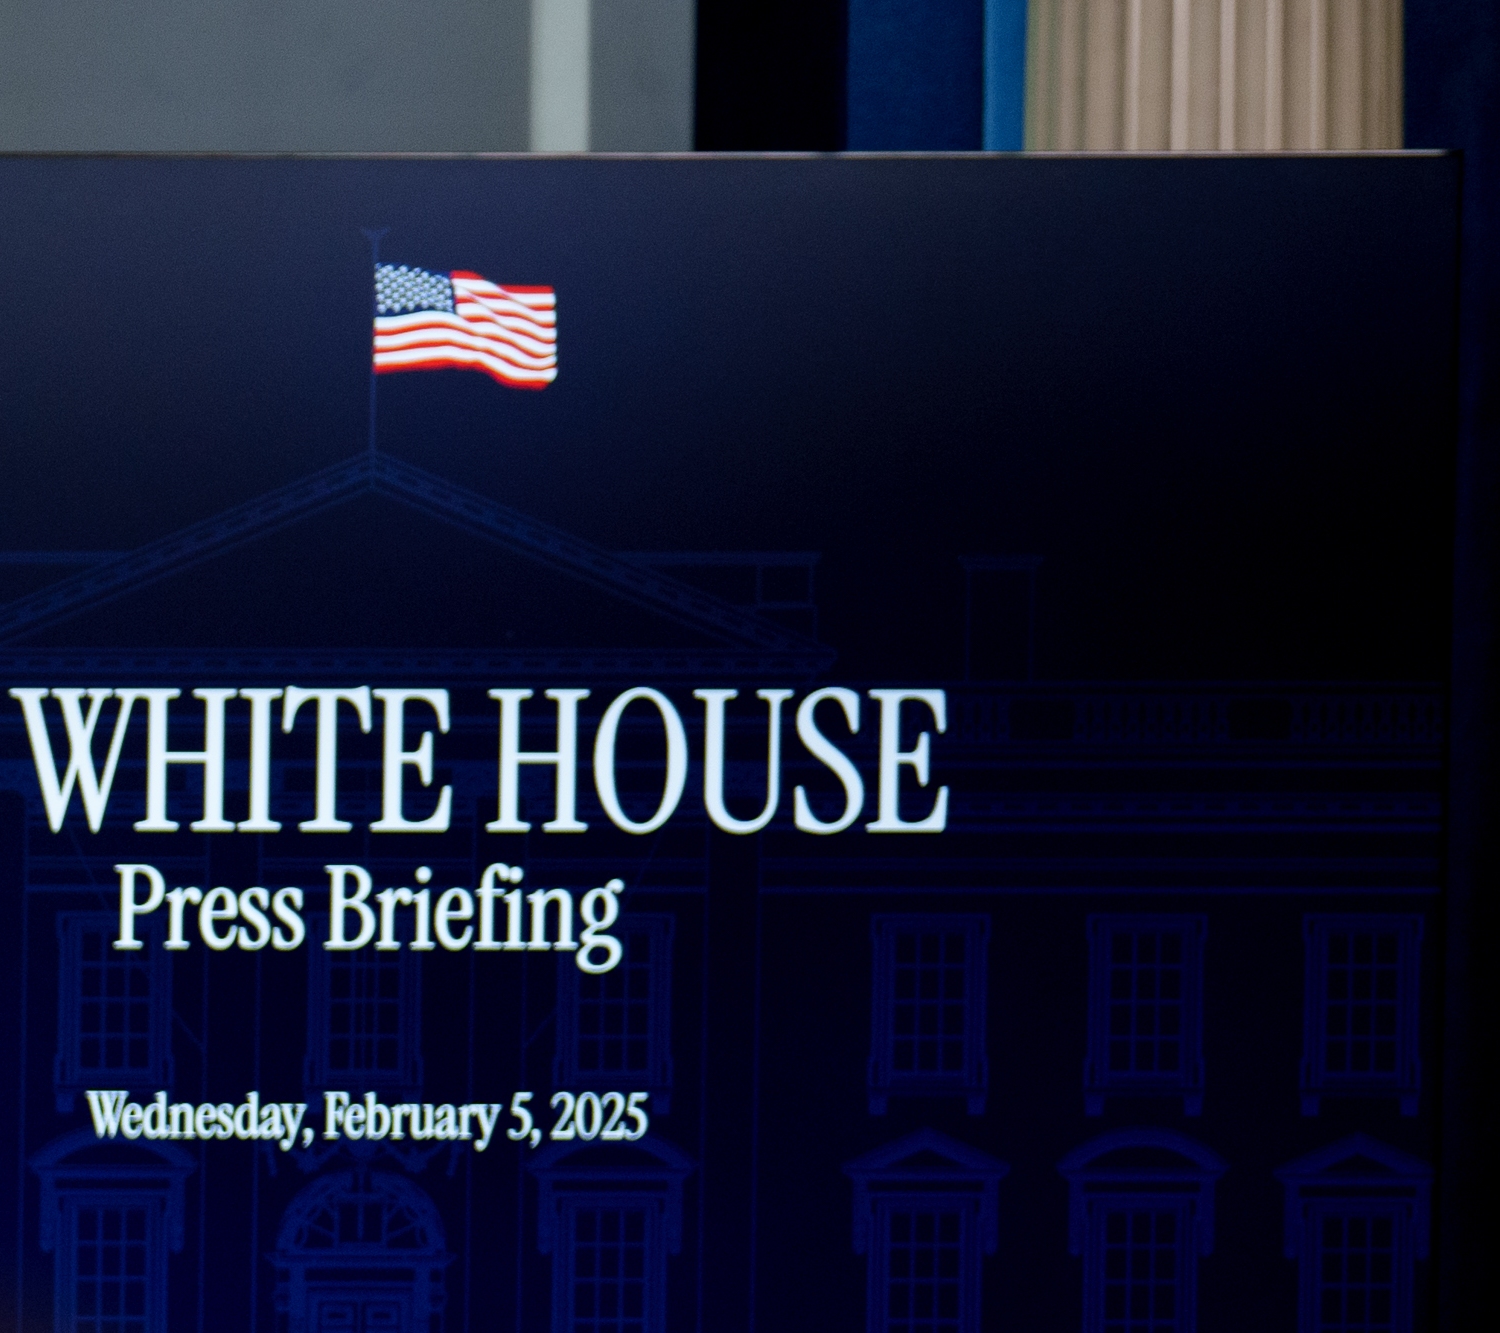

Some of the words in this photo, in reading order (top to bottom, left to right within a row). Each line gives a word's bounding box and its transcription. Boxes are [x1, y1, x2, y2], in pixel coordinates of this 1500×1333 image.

[9, 686, 452, 832] WHITE
[486, 687, 948, 833] HOUSE
[114, 864, 305, 950] Press
[324, 863, 624, 973] Briefing
[86, 1091, 313, 1150] Wednesday,
[324, 1092, 501, 1151] February
[508, 1092, 541, 1146] 5,
[551, 1092, 647, 1140] 2025
